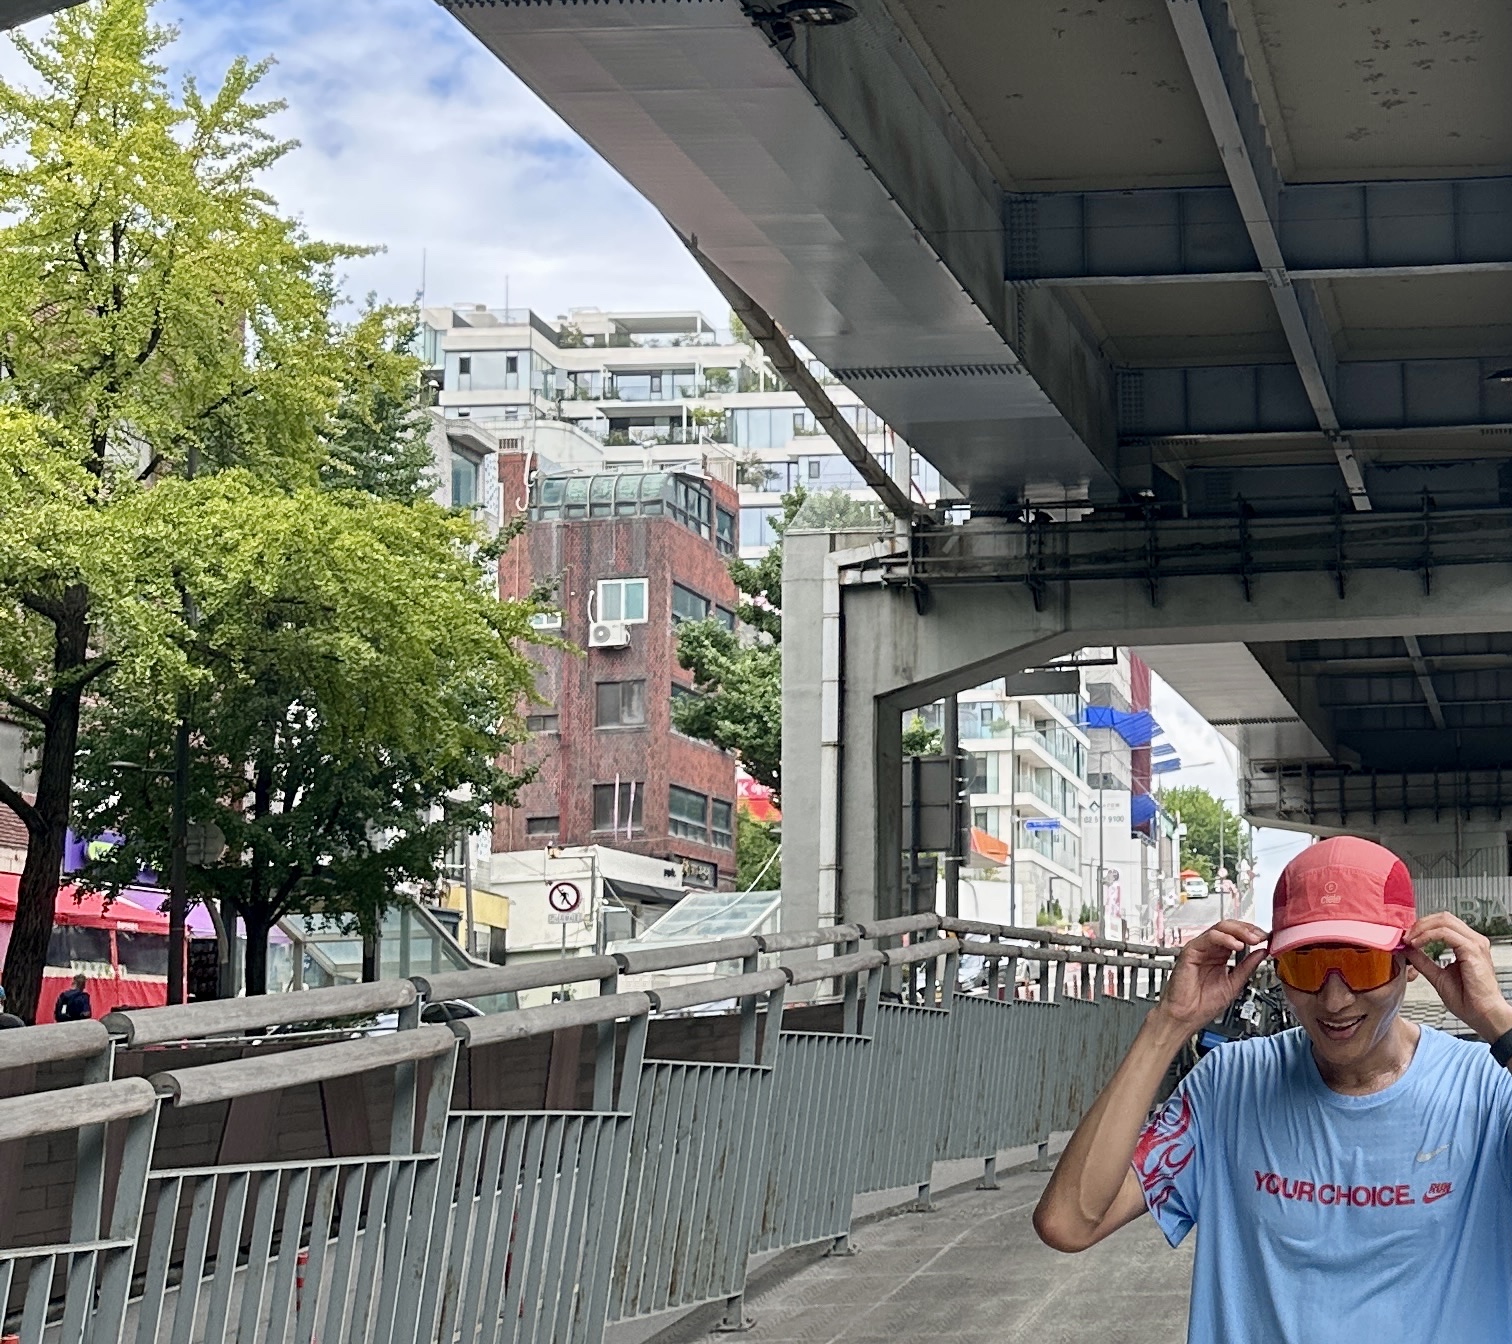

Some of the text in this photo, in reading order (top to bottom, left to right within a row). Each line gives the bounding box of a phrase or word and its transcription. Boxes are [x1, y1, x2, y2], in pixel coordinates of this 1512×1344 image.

[1254, 1170, 1415, 1207] YOUR CHOICE.
[1428, 1182, 1452, 1195] RUN
